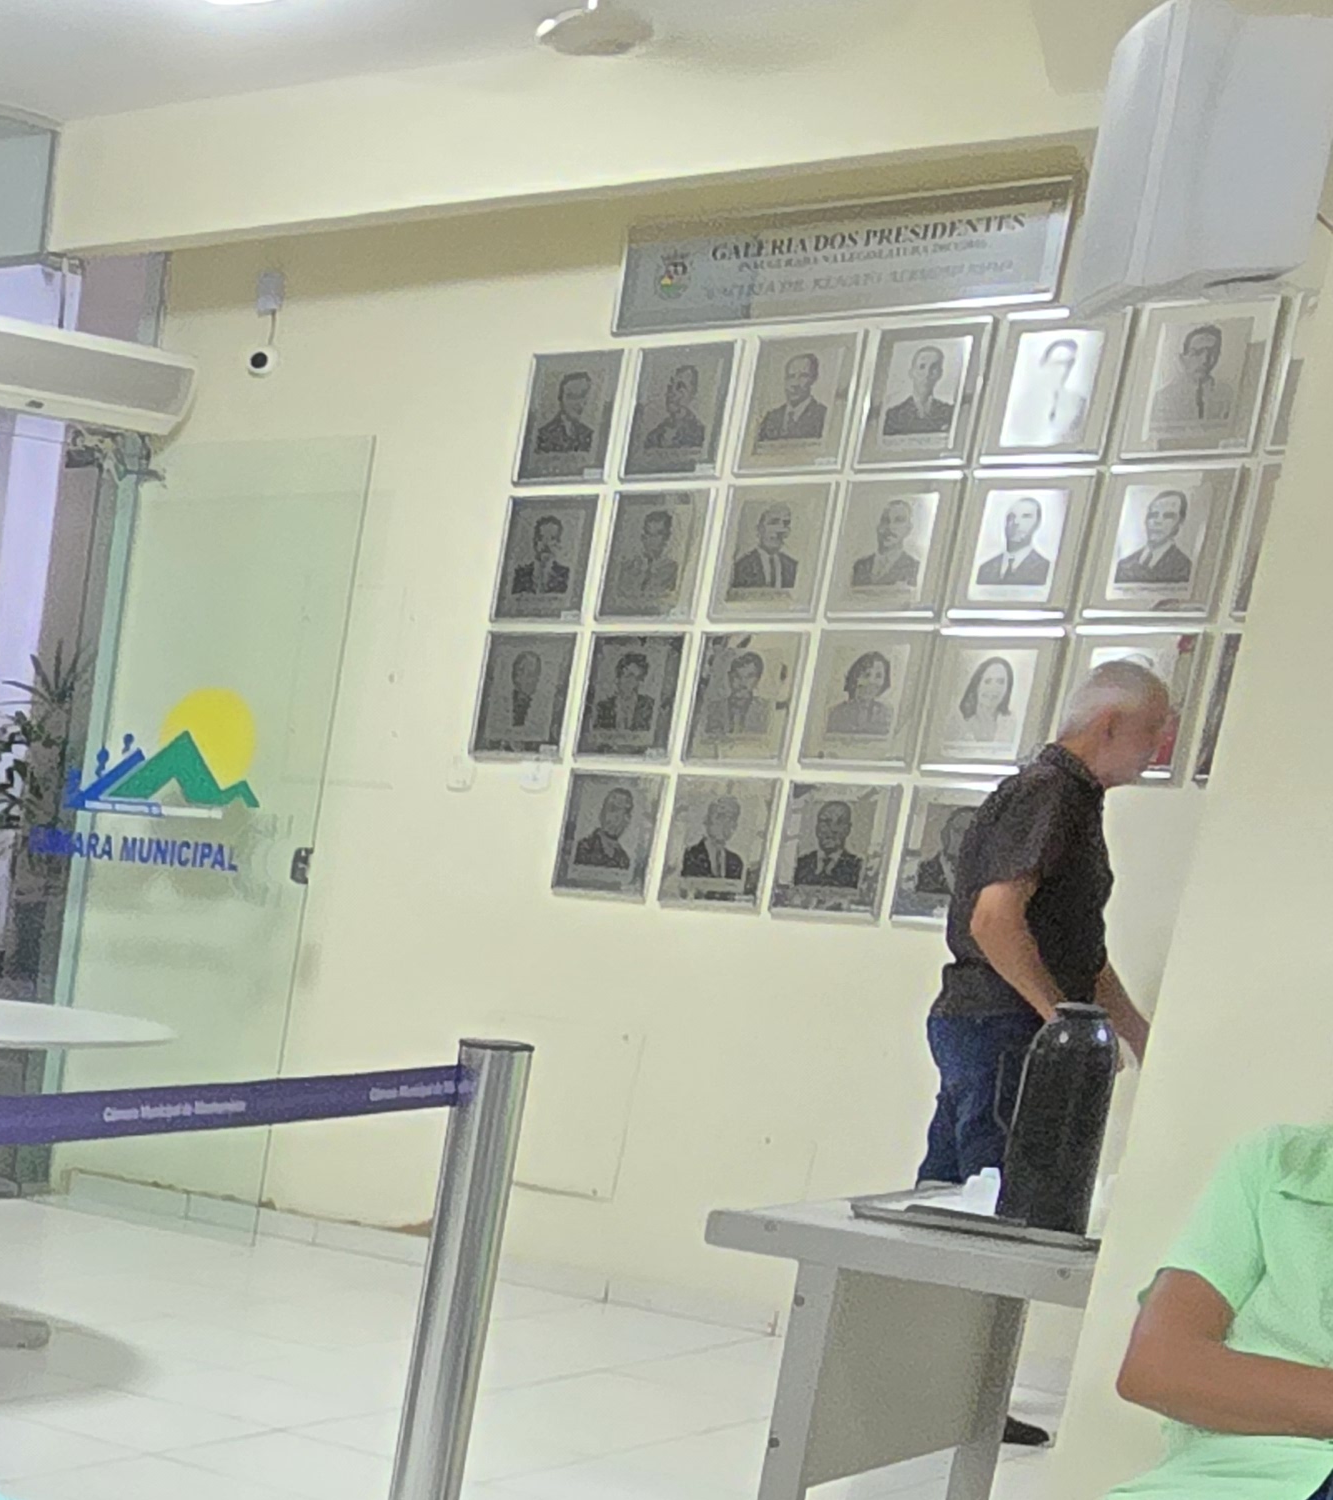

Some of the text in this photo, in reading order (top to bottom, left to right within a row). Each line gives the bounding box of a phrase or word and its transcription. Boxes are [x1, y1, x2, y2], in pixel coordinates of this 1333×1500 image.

[712, 235, 807, 261] GALERIA
[814, 231, 859, 252] DOS
[864, 213, 1027, 247] PRESIDENTES
[29, 825, 240, 872] ARA MUNICIPAL
